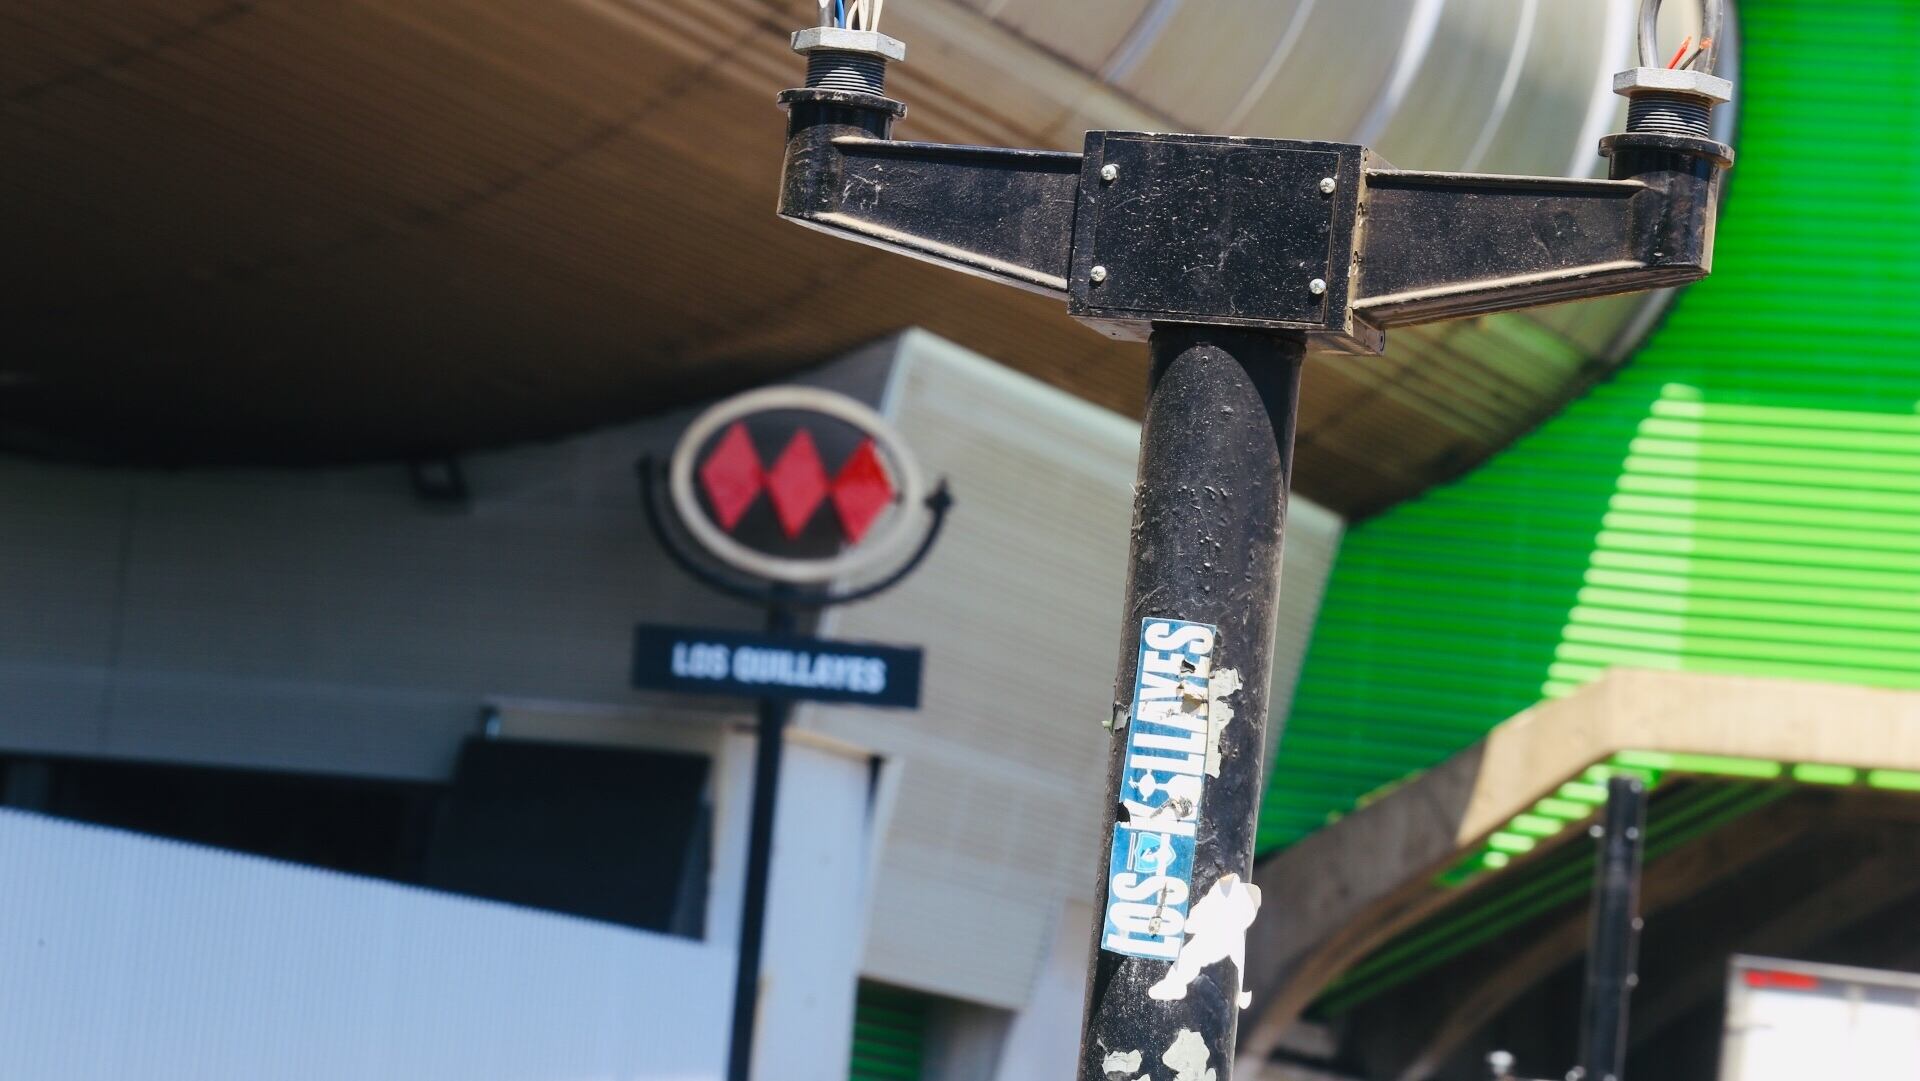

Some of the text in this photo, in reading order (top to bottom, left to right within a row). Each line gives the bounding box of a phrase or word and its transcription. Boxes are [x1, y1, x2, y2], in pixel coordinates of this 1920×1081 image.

[672, 641, 887, 694] LOS QUILLAYES
[1106, 873, 1189, 960] LOS
